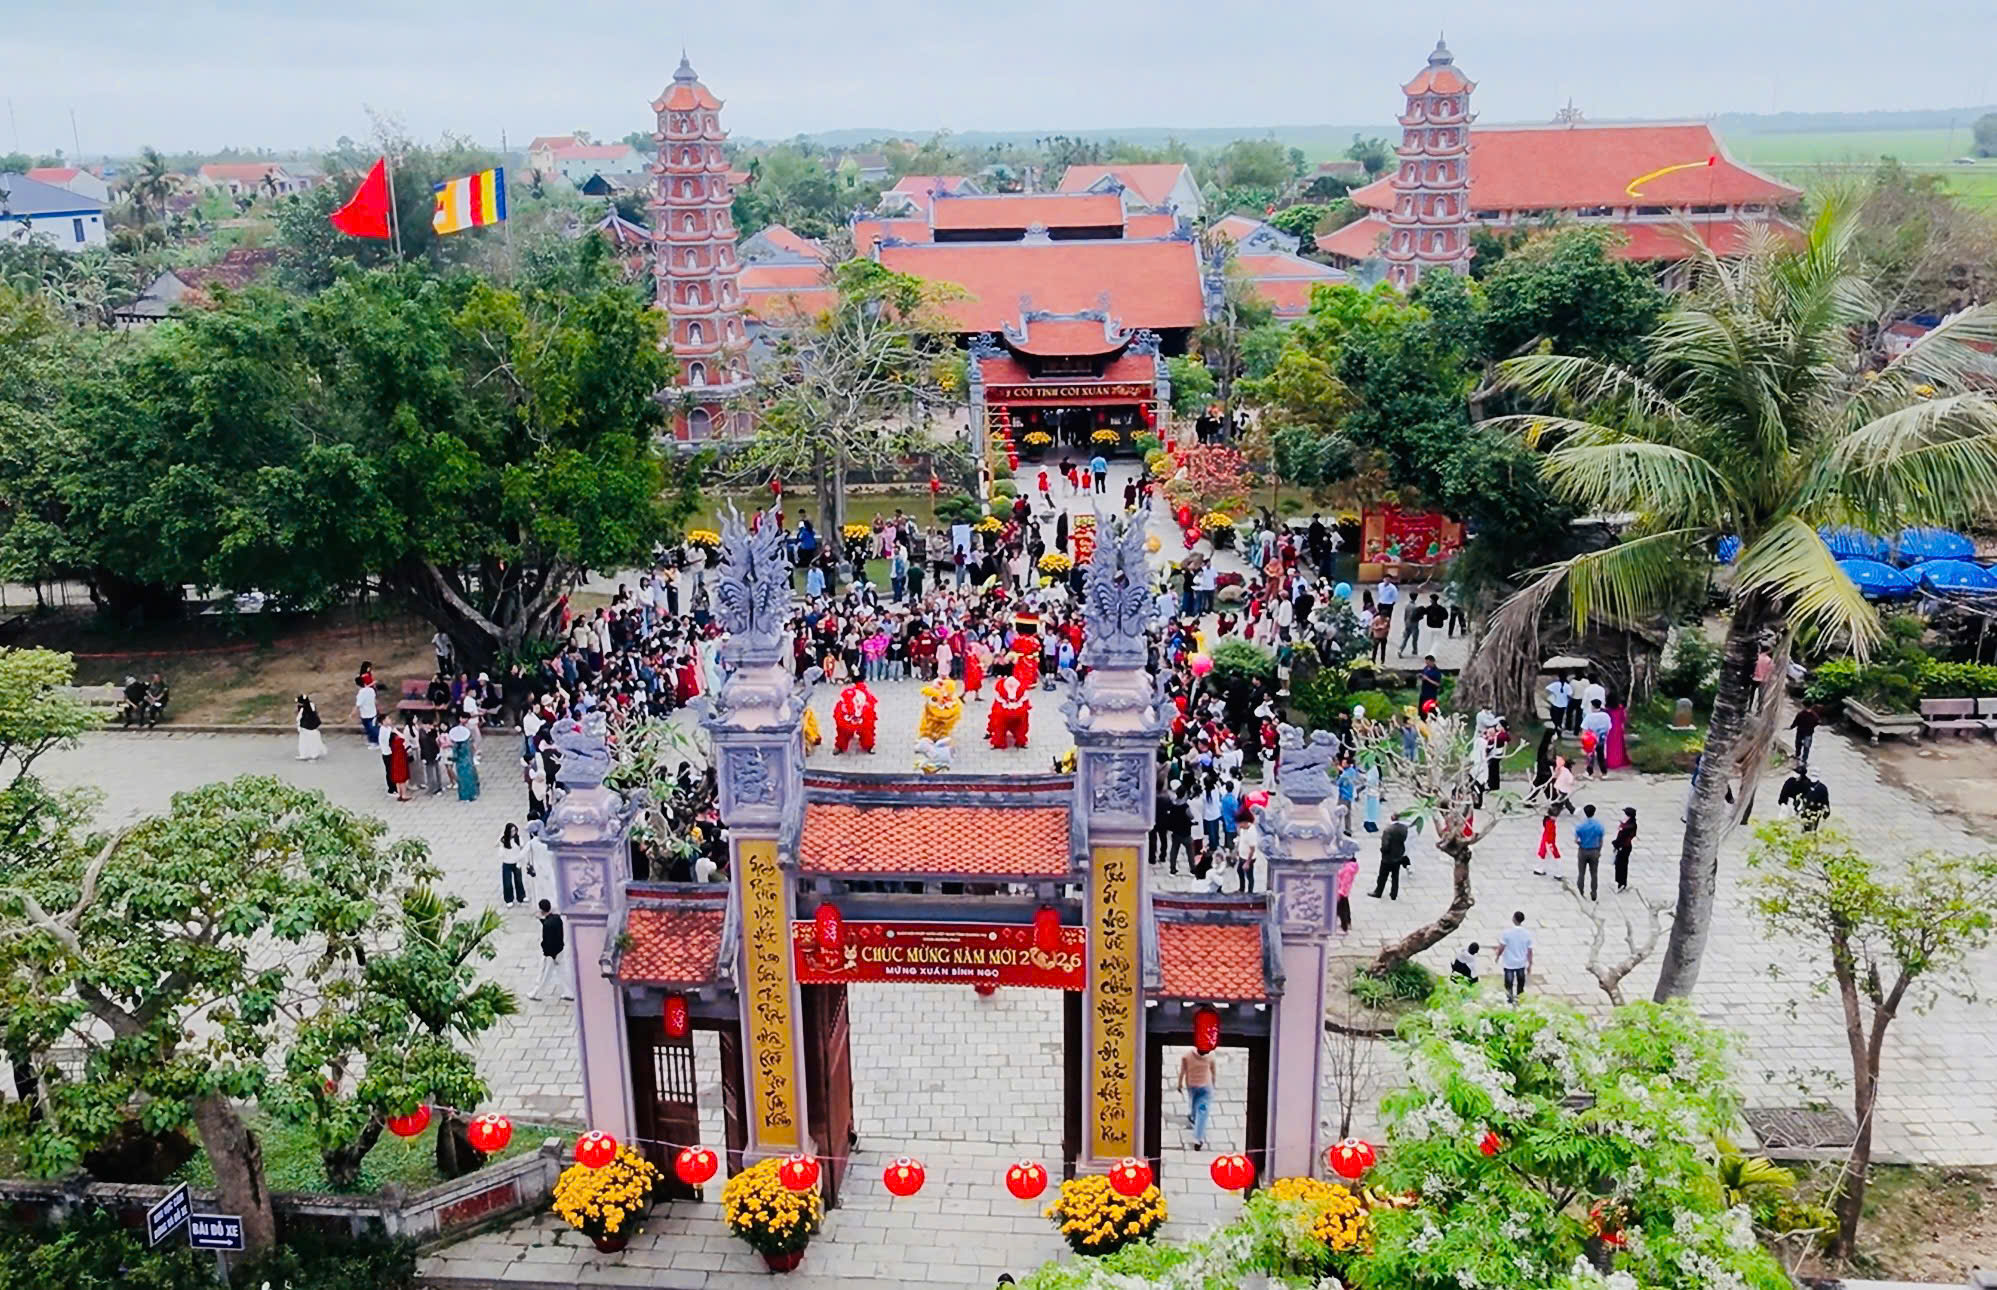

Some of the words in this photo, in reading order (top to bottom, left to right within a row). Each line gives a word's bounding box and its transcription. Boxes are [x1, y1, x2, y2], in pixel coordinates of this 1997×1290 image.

[861, 943, 903, 963] CHÚC
[907, 944, 950, 963] MỪNG
[989, 946, 1016, 965] MỚI
[885, 965, 917, 975] MỪNG
[920, 965, 949, 975] XUÂN
[977, 968, 999, 978] NGỌ
[226, 1224, 239, 1237] XE
